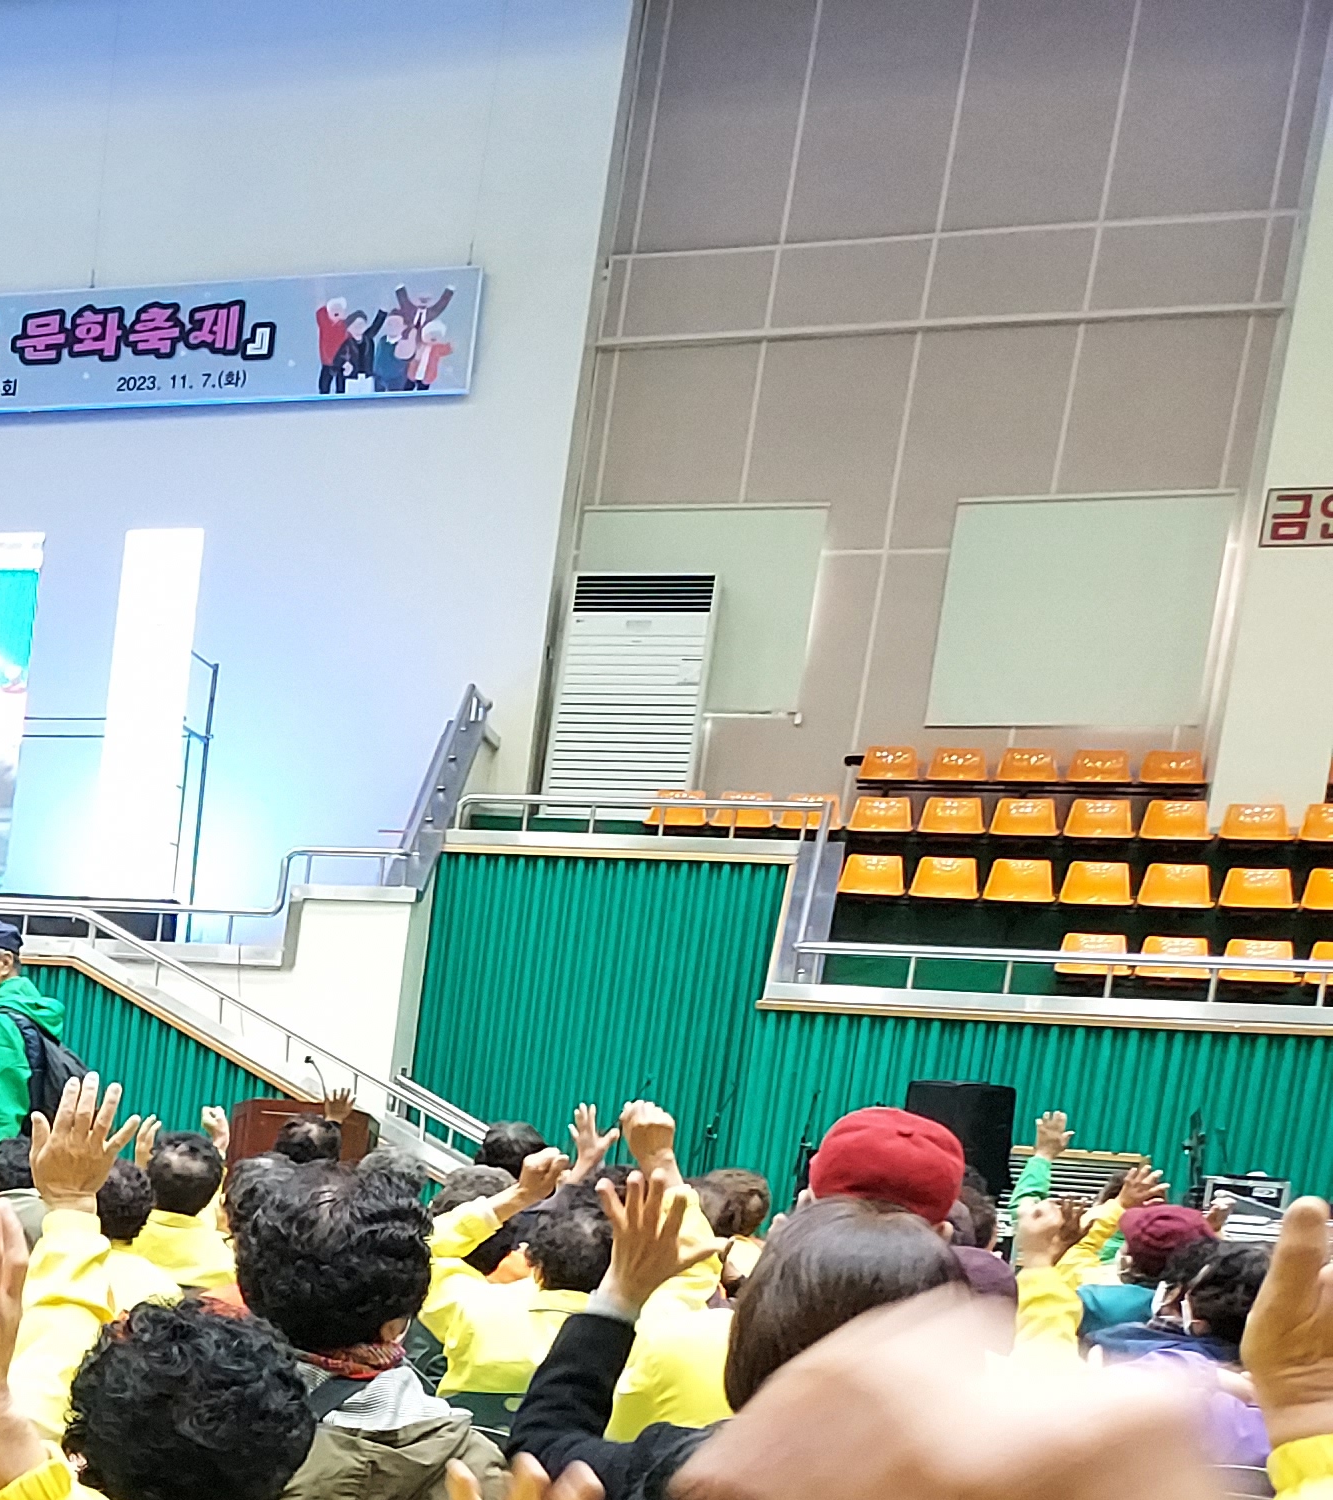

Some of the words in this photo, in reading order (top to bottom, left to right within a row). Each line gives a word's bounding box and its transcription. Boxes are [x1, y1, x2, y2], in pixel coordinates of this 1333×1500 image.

[12, 301, 275, 364] 문화축제』
[116, 375, 162, 392] 2023.
[170, 374, 194, 390] 11.
